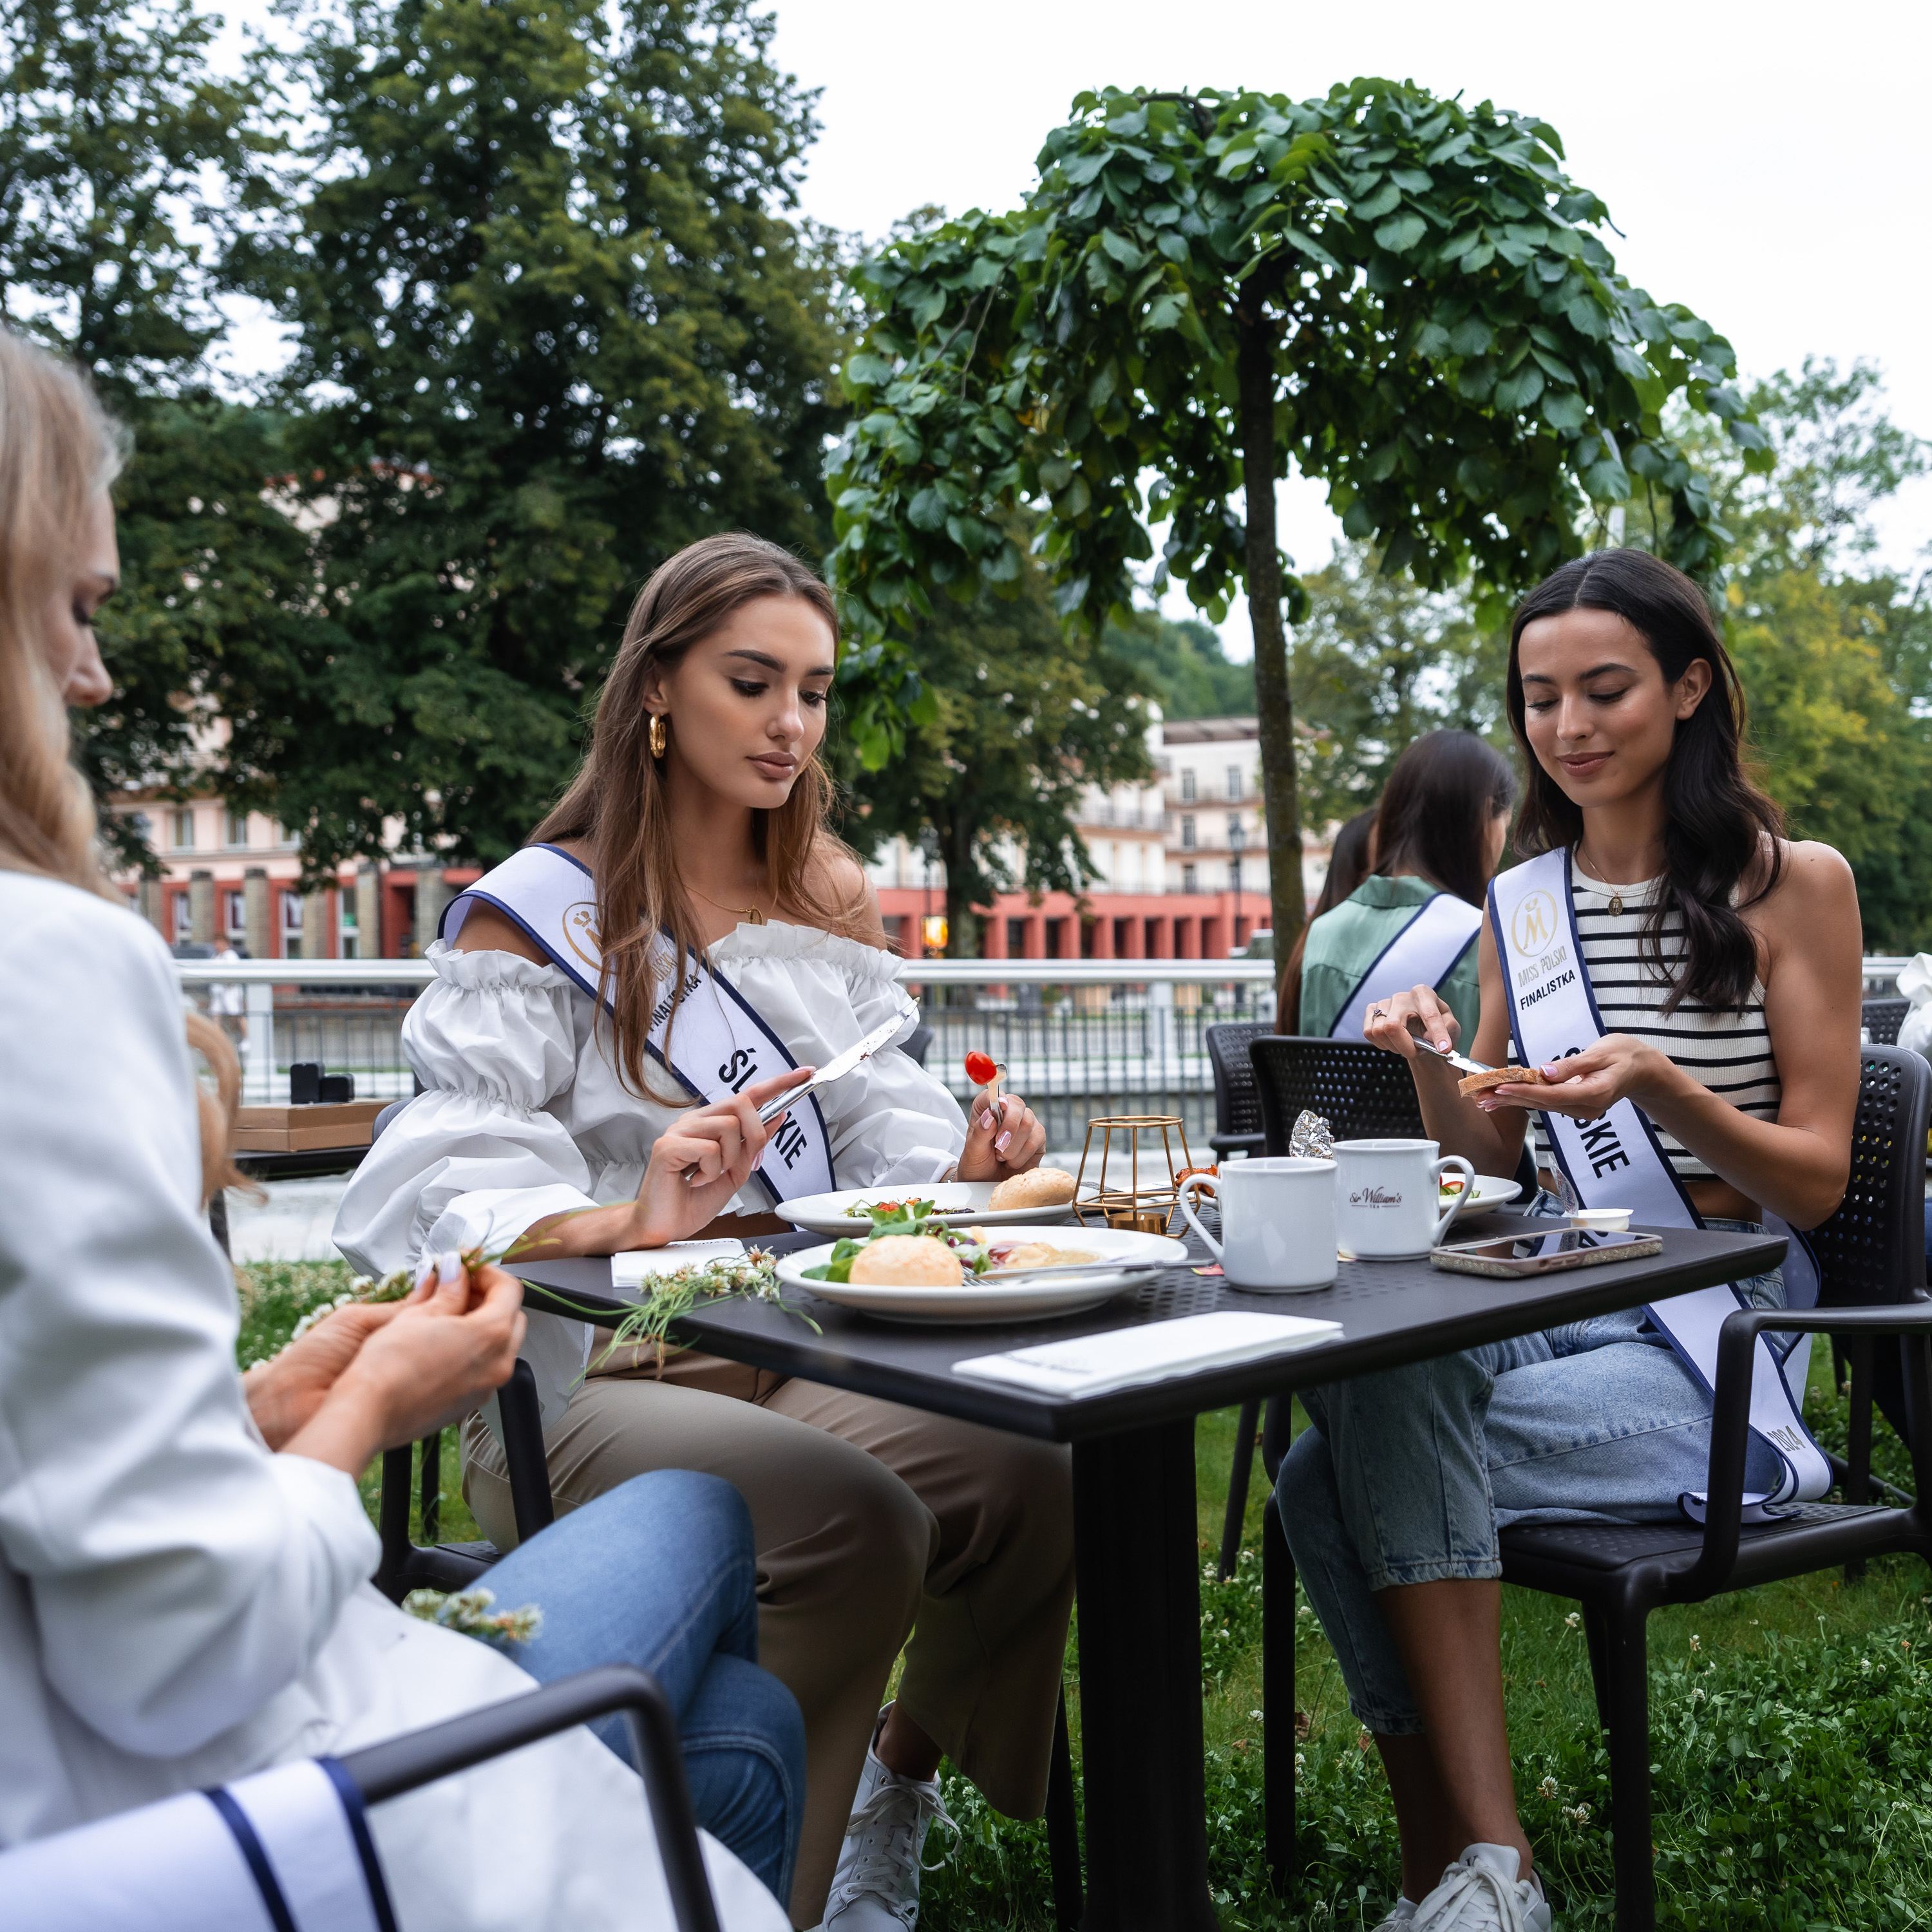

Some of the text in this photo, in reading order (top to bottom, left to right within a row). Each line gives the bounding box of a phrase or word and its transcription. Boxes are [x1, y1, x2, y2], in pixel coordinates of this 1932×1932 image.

[651, 952, 678, 981] OLSKI
[1518, 945, 1567, 987] MISS POLSKI
[1520, 969, 1575, 1010] FINALISTKA
[719, 1048, 808, 1170] ŚLKIE
[1350, 1186, 1402, 1203] Sir William's
[1766, 1425, 1806, 1452] 2024
